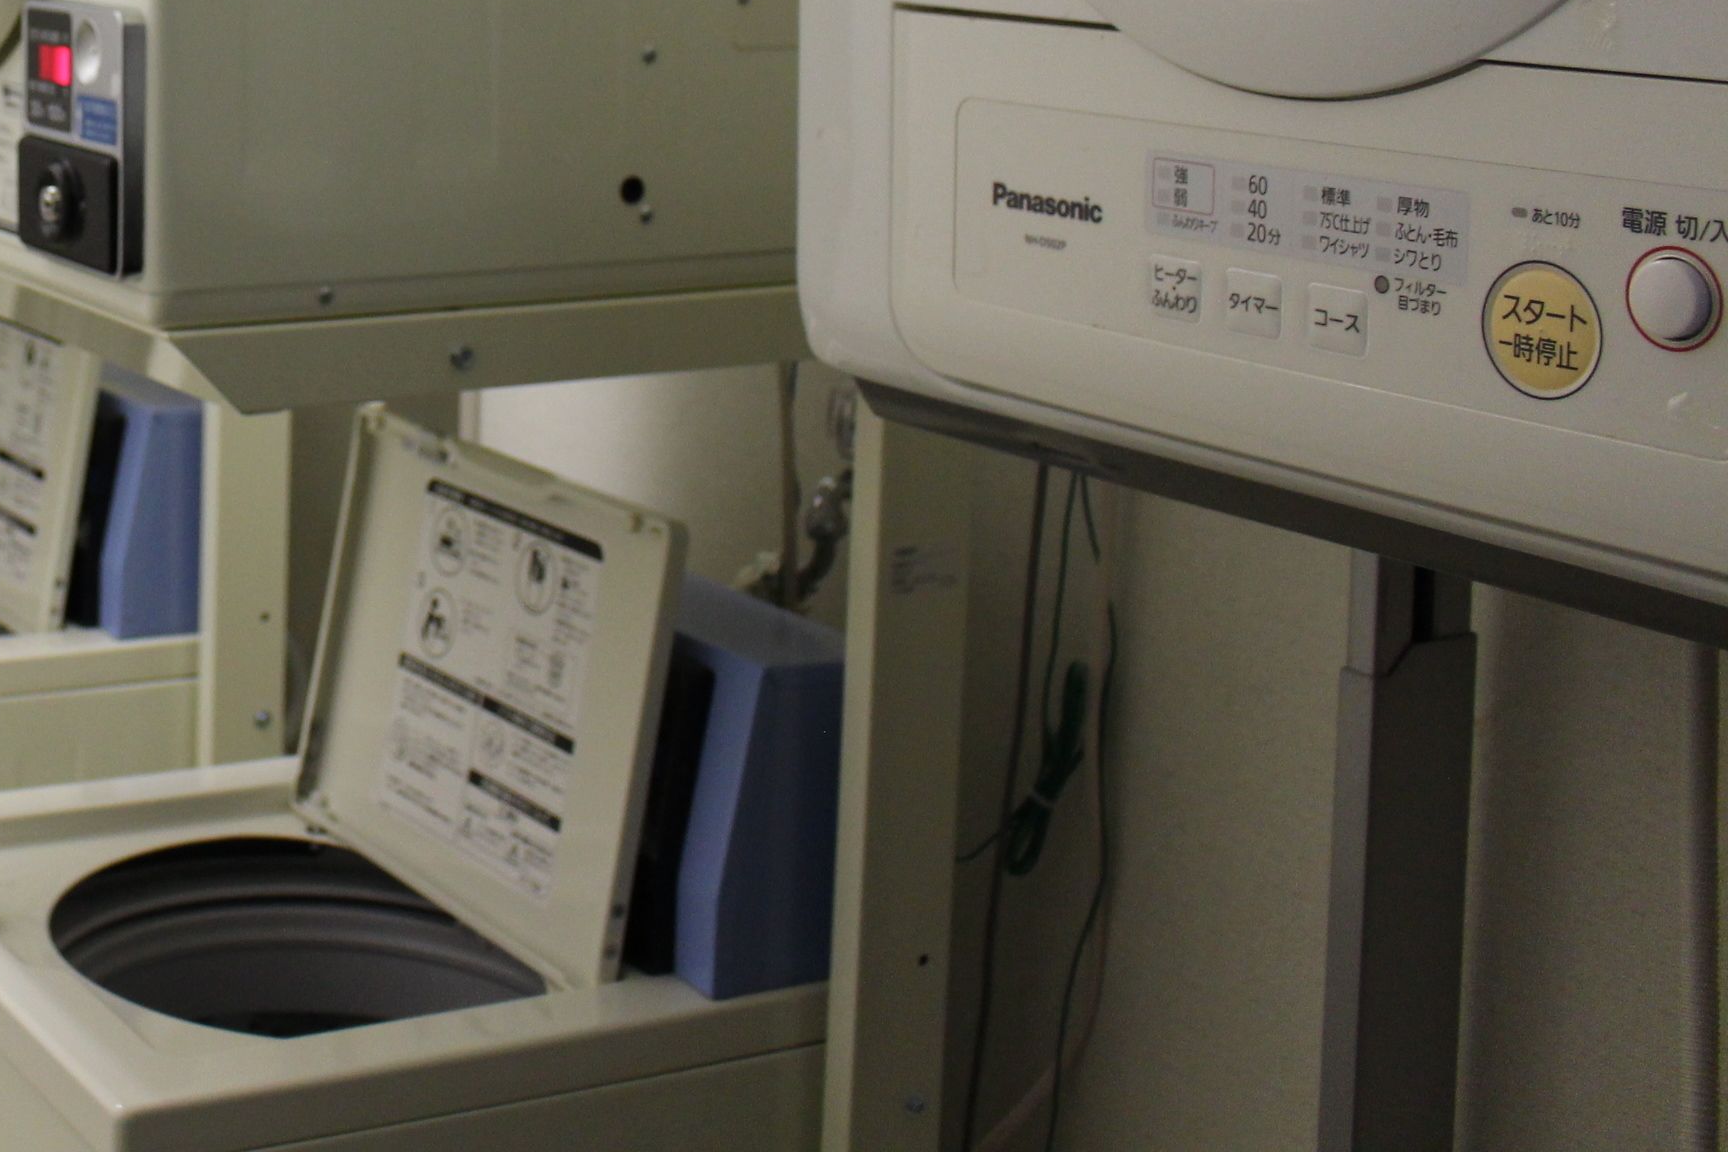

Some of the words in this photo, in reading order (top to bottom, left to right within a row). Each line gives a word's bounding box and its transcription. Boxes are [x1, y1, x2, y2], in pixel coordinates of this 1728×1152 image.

[1174, 164, 1188, 185] 強
[1248, 175, 1268, 196] 60
[992, 180, 1103, 224] Panasonic
[1174, 187, 1188, 208] 弱
[1321, 186, 1351, 207] 標準
[1397, 196, 1430, 219] 厚物
[1247, 199, 1267, 219] 40
[1532, 208, 1581, 228] あと10分
[1622, 206, 1668, 236] 電源
[1247, 222, 1281, 247] 20分
[1319, 235, 1370, 259] ワイシャツ
[1393, 249, 1442, 272] シワとり
[1154, 264, 1198, 285] ヒーター
[1393, 277, 1447, 297] フィルター
[1228, 292, 1280, 314] タイマー
[1398, 295, 1442, 316] 目づまり
[1502, 294, 1588, 333] スタート
[1314, 308, 1361, 334] コース
[1498, 332, 1579, 371] 一時停止
